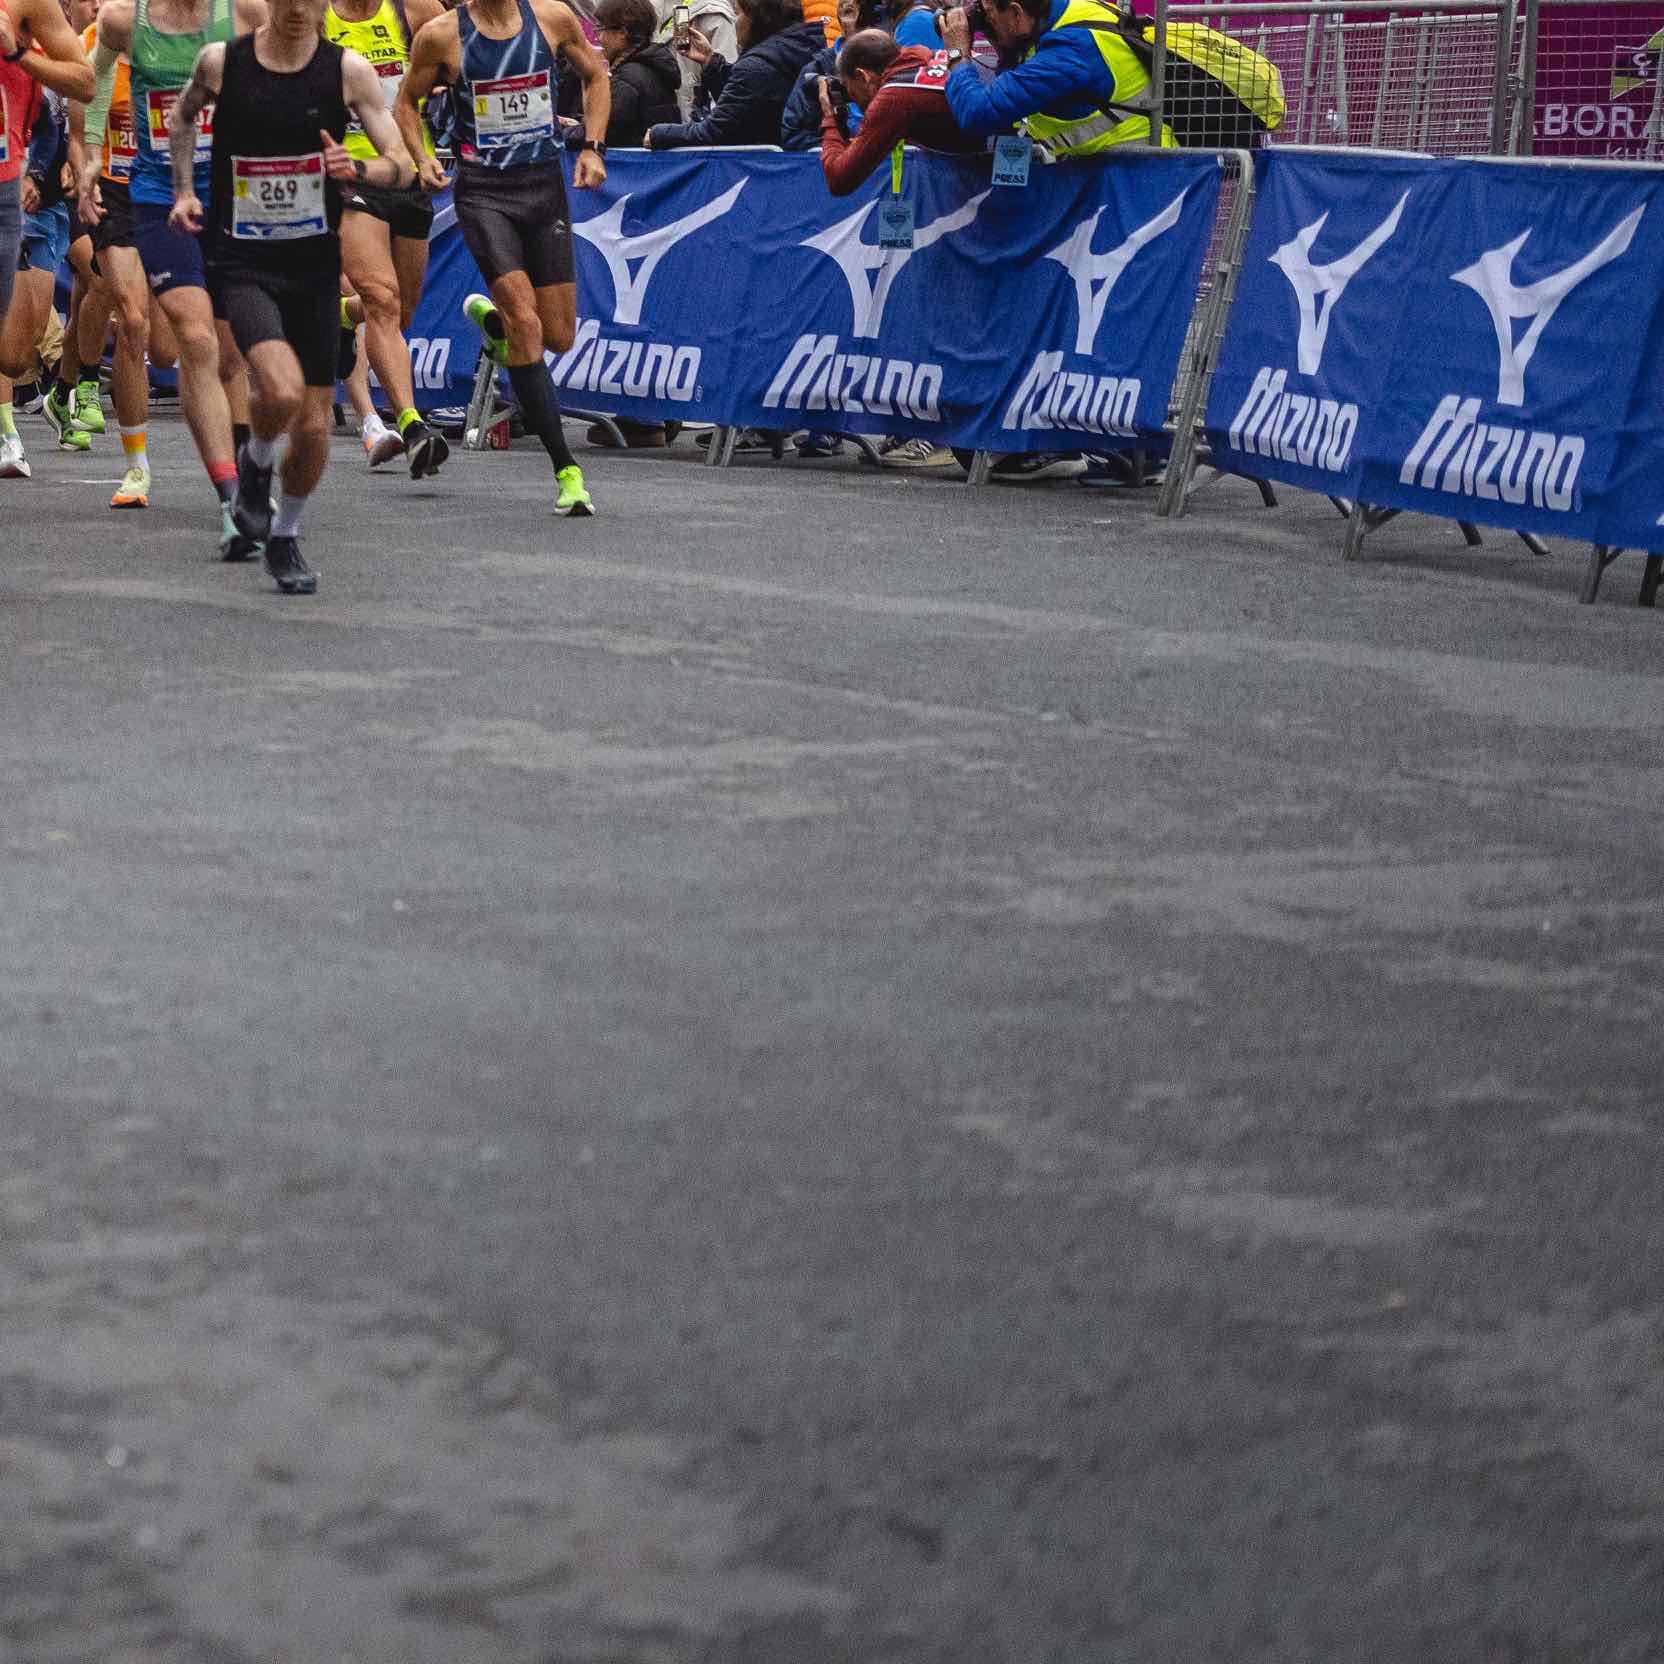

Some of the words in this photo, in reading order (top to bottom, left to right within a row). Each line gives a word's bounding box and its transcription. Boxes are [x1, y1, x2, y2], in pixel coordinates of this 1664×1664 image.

[500, 93, 529, 113] 149
[260, 180, 298, 201] 269
[995, 172, 1026, 184] PRESS
[880, 238, 912, 249] PRESS
[763, 334, 943, 422] MIZUNO
[1003, 349, 1142, 437] MIZUNO
[1229, 367, 1360, 473] MIZUNO
[1399, 395, 1585, 512] MIZUNO
